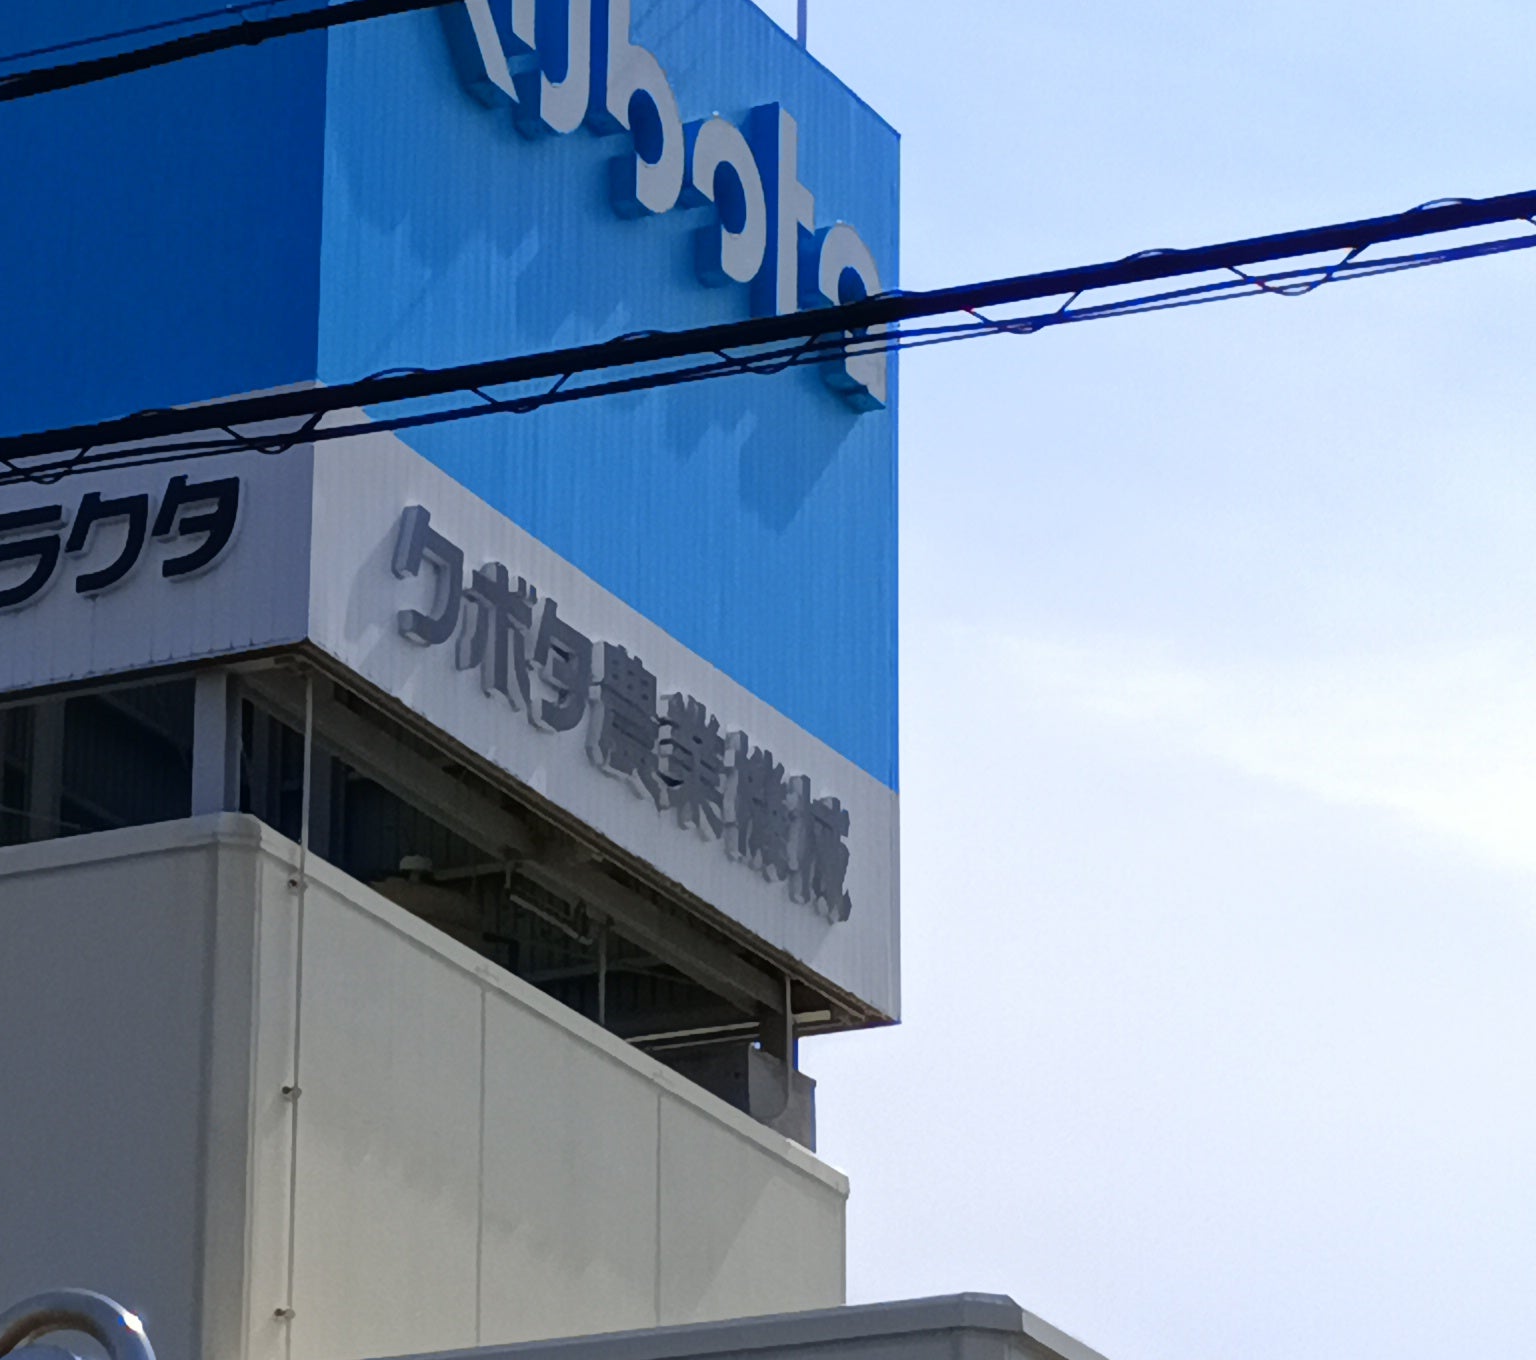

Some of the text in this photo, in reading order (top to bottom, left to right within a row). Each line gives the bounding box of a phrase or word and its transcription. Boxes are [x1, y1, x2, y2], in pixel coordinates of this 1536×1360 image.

[391, 504, 853, 924] クボタ農業機械
